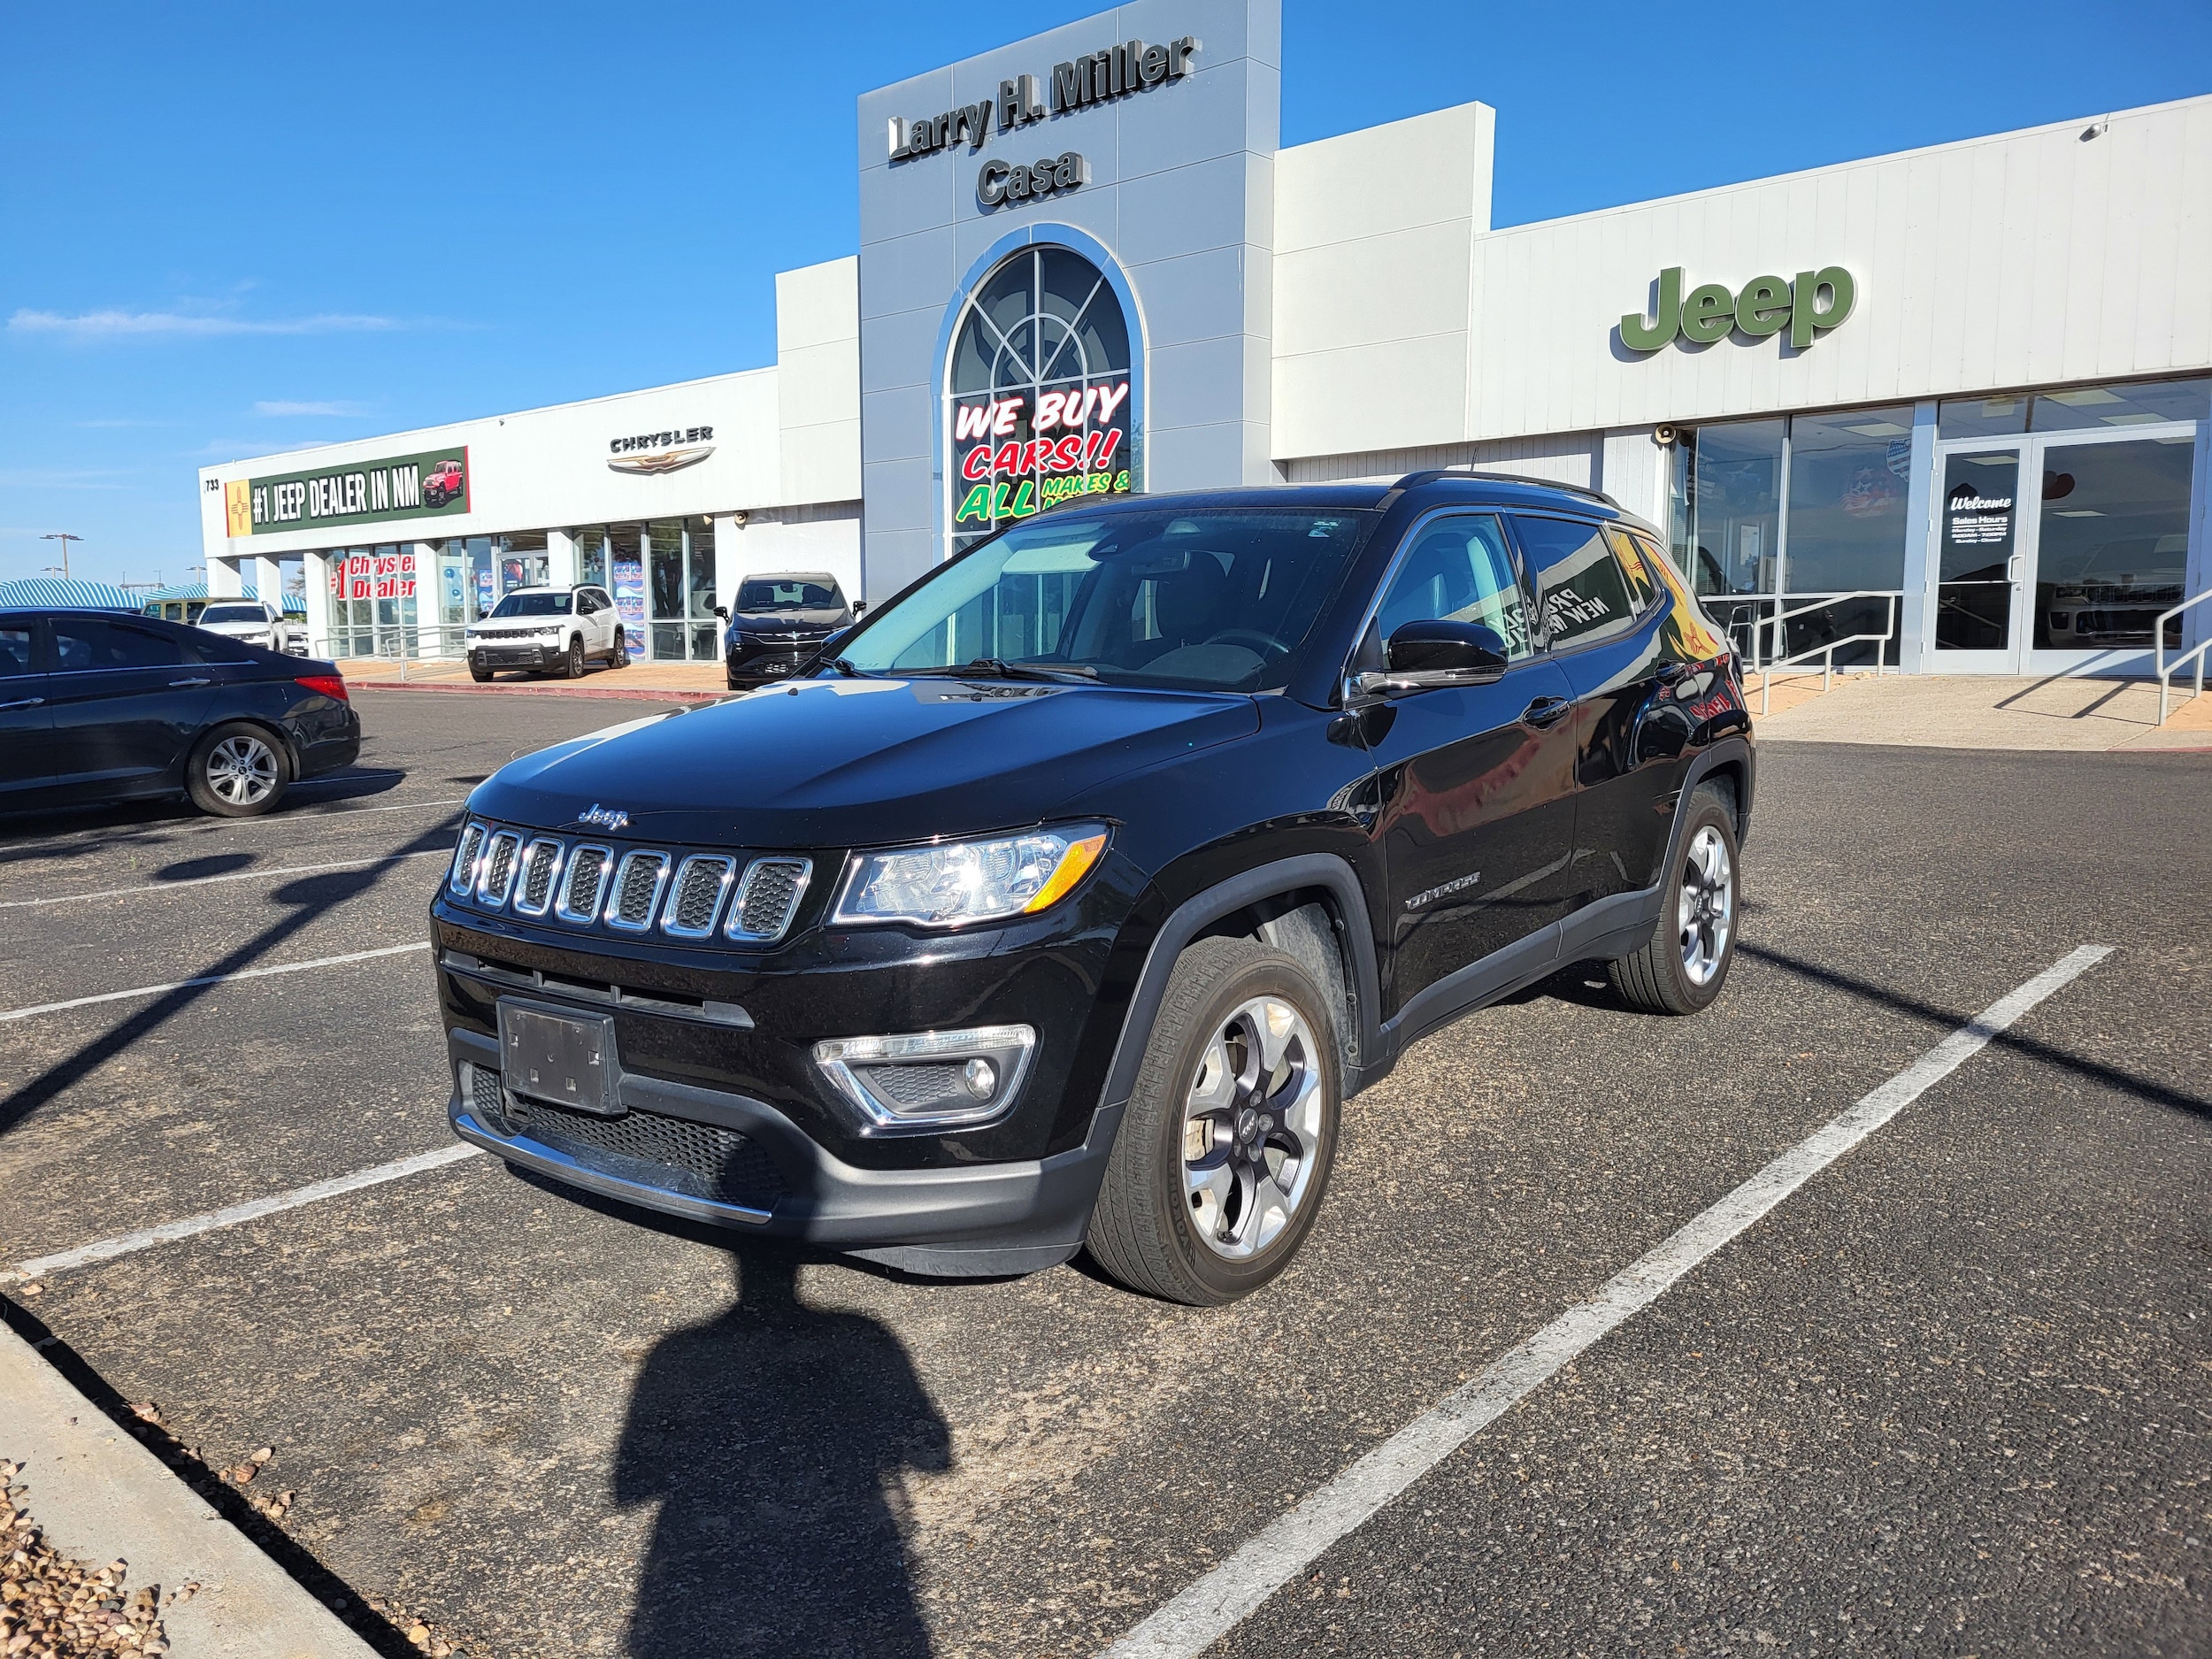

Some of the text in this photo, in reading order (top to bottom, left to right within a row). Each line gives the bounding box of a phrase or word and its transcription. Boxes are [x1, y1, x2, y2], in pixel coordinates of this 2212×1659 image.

[888, 35, 1194, 161] Larry H. Miller
[978, 151, 1085, 206] Casa
[1619, 265, 1858, 351] Jeep
[956, 382, 1129, 441] WE BUY
[611, 426, 713, 453] CHRYSLER
[962, 428, 1123, 480] CARS!!
[206, 479, 219, 492] 733
[253, 465, 420, 523] #1 JEEP DEALER IN NM
[956, 480, 1036, 522] ALL
[1041, 472, 1112, 497] MAKES
[1113, 470, 1131, 490] &
[1951, 496, 2012, 511] Welcome
[330, 558, 347, 601] #1
[349, 554, 416, 576] Chyse
[579, 803, 628, 831] Jeep
